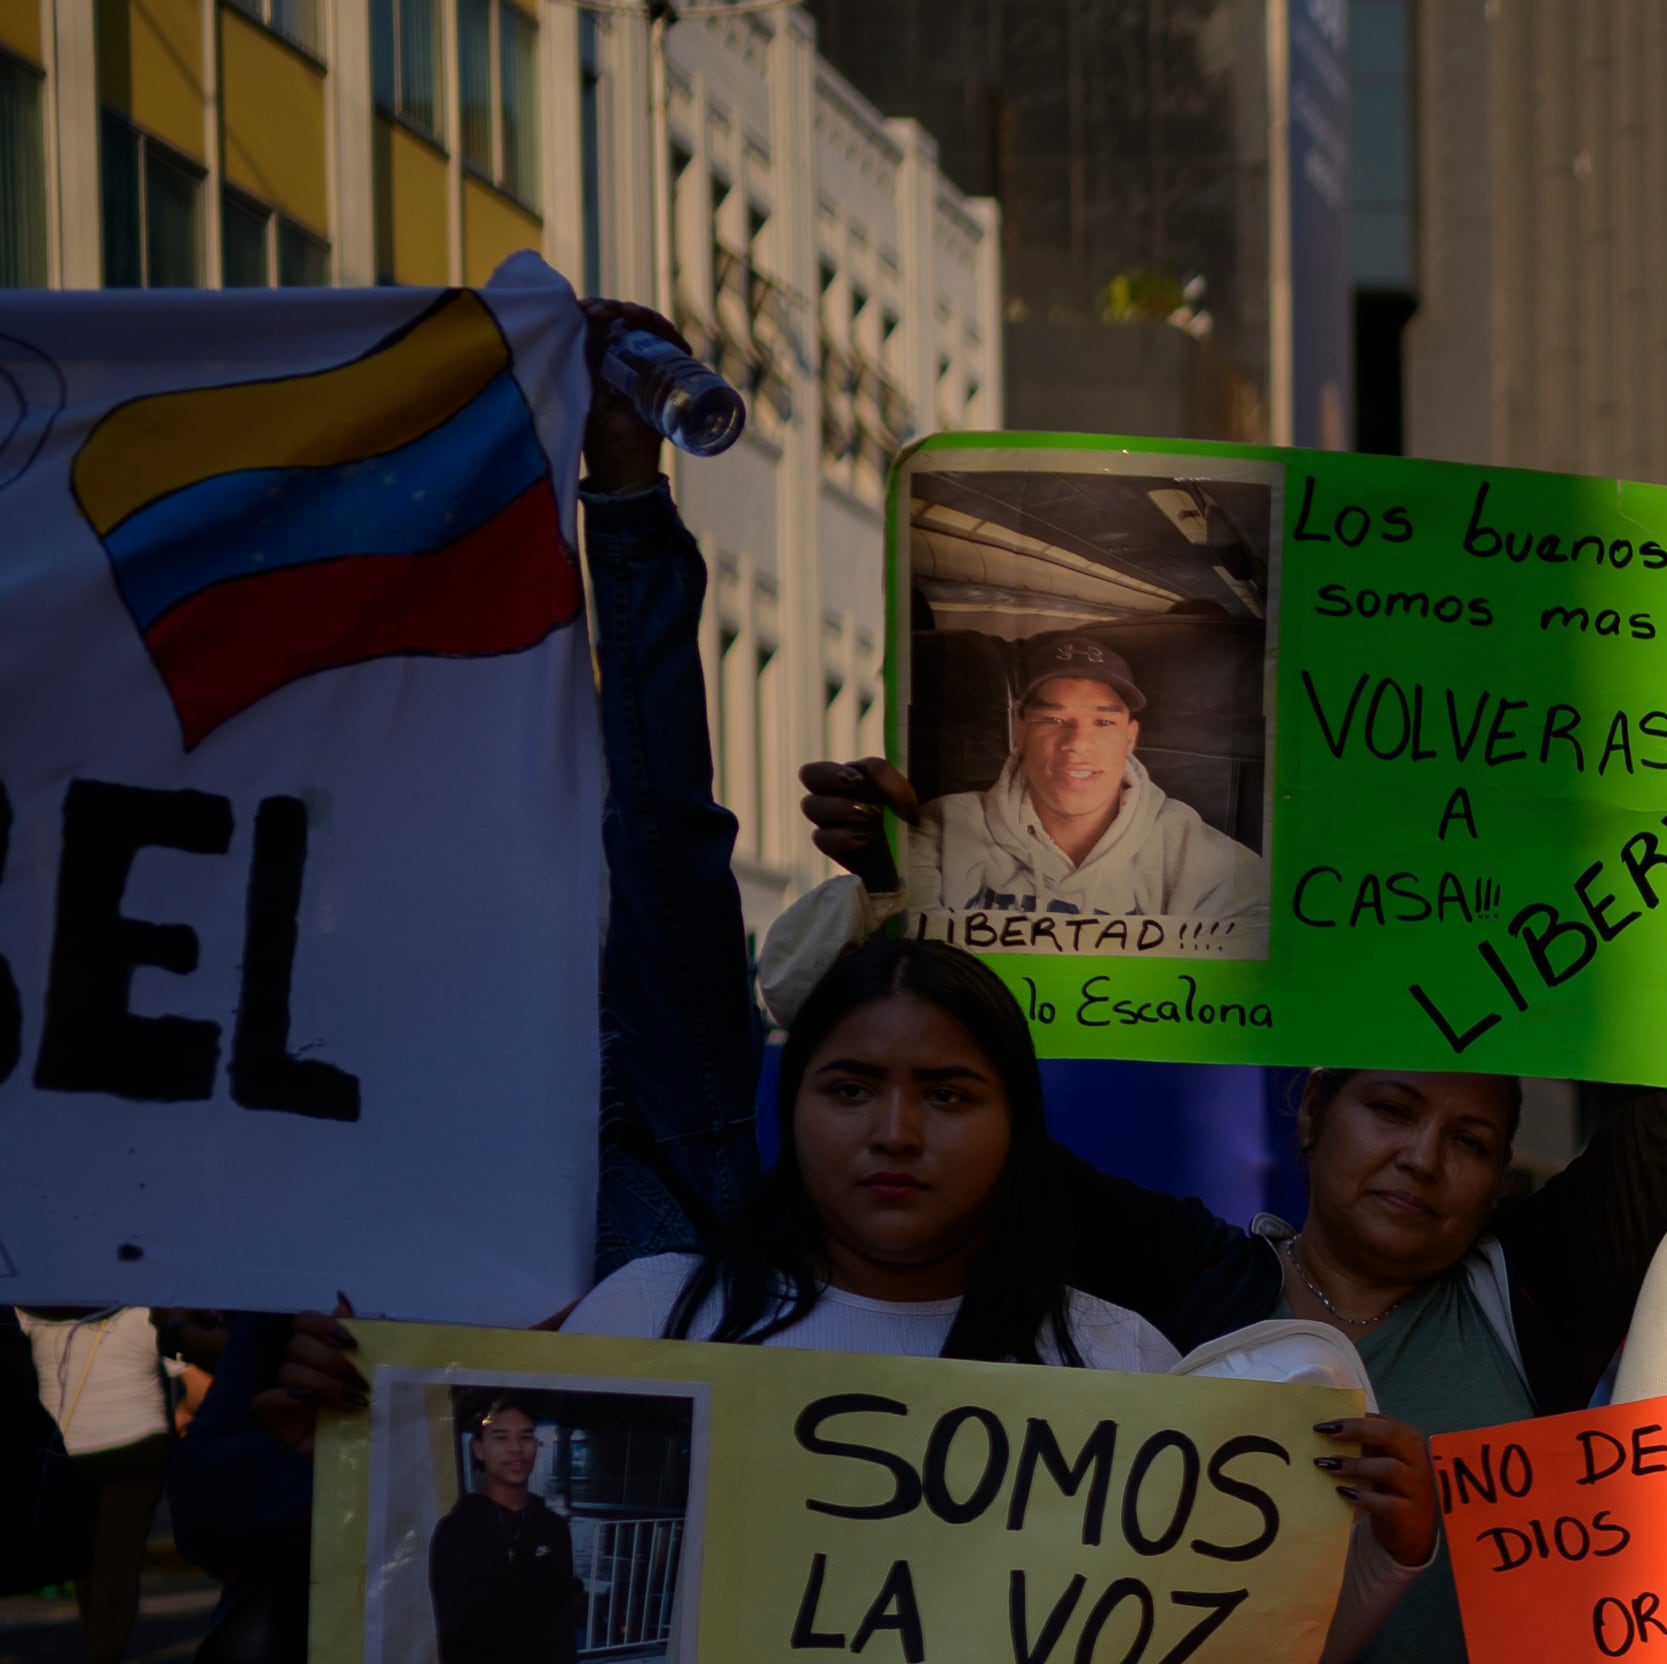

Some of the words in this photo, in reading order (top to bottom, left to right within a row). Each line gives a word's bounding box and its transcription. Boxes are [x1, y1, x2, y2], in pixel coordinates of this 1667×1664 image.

[1293, 477, 1414, 547] Los
[1315, 583, 1494, 627] somos
[1438, 787, 1478, 841] A
[1293, 865, 1503, 929] CASA!!!
[0, 778, 360, 1122] EL
[1077, 975, 1273, 1028] Escalona
[793, 1391, 1291, 1563] SOMOS
[1476, 1511, 1631, 1573] DIOS
[790, 1552, 926, 1664] LA
